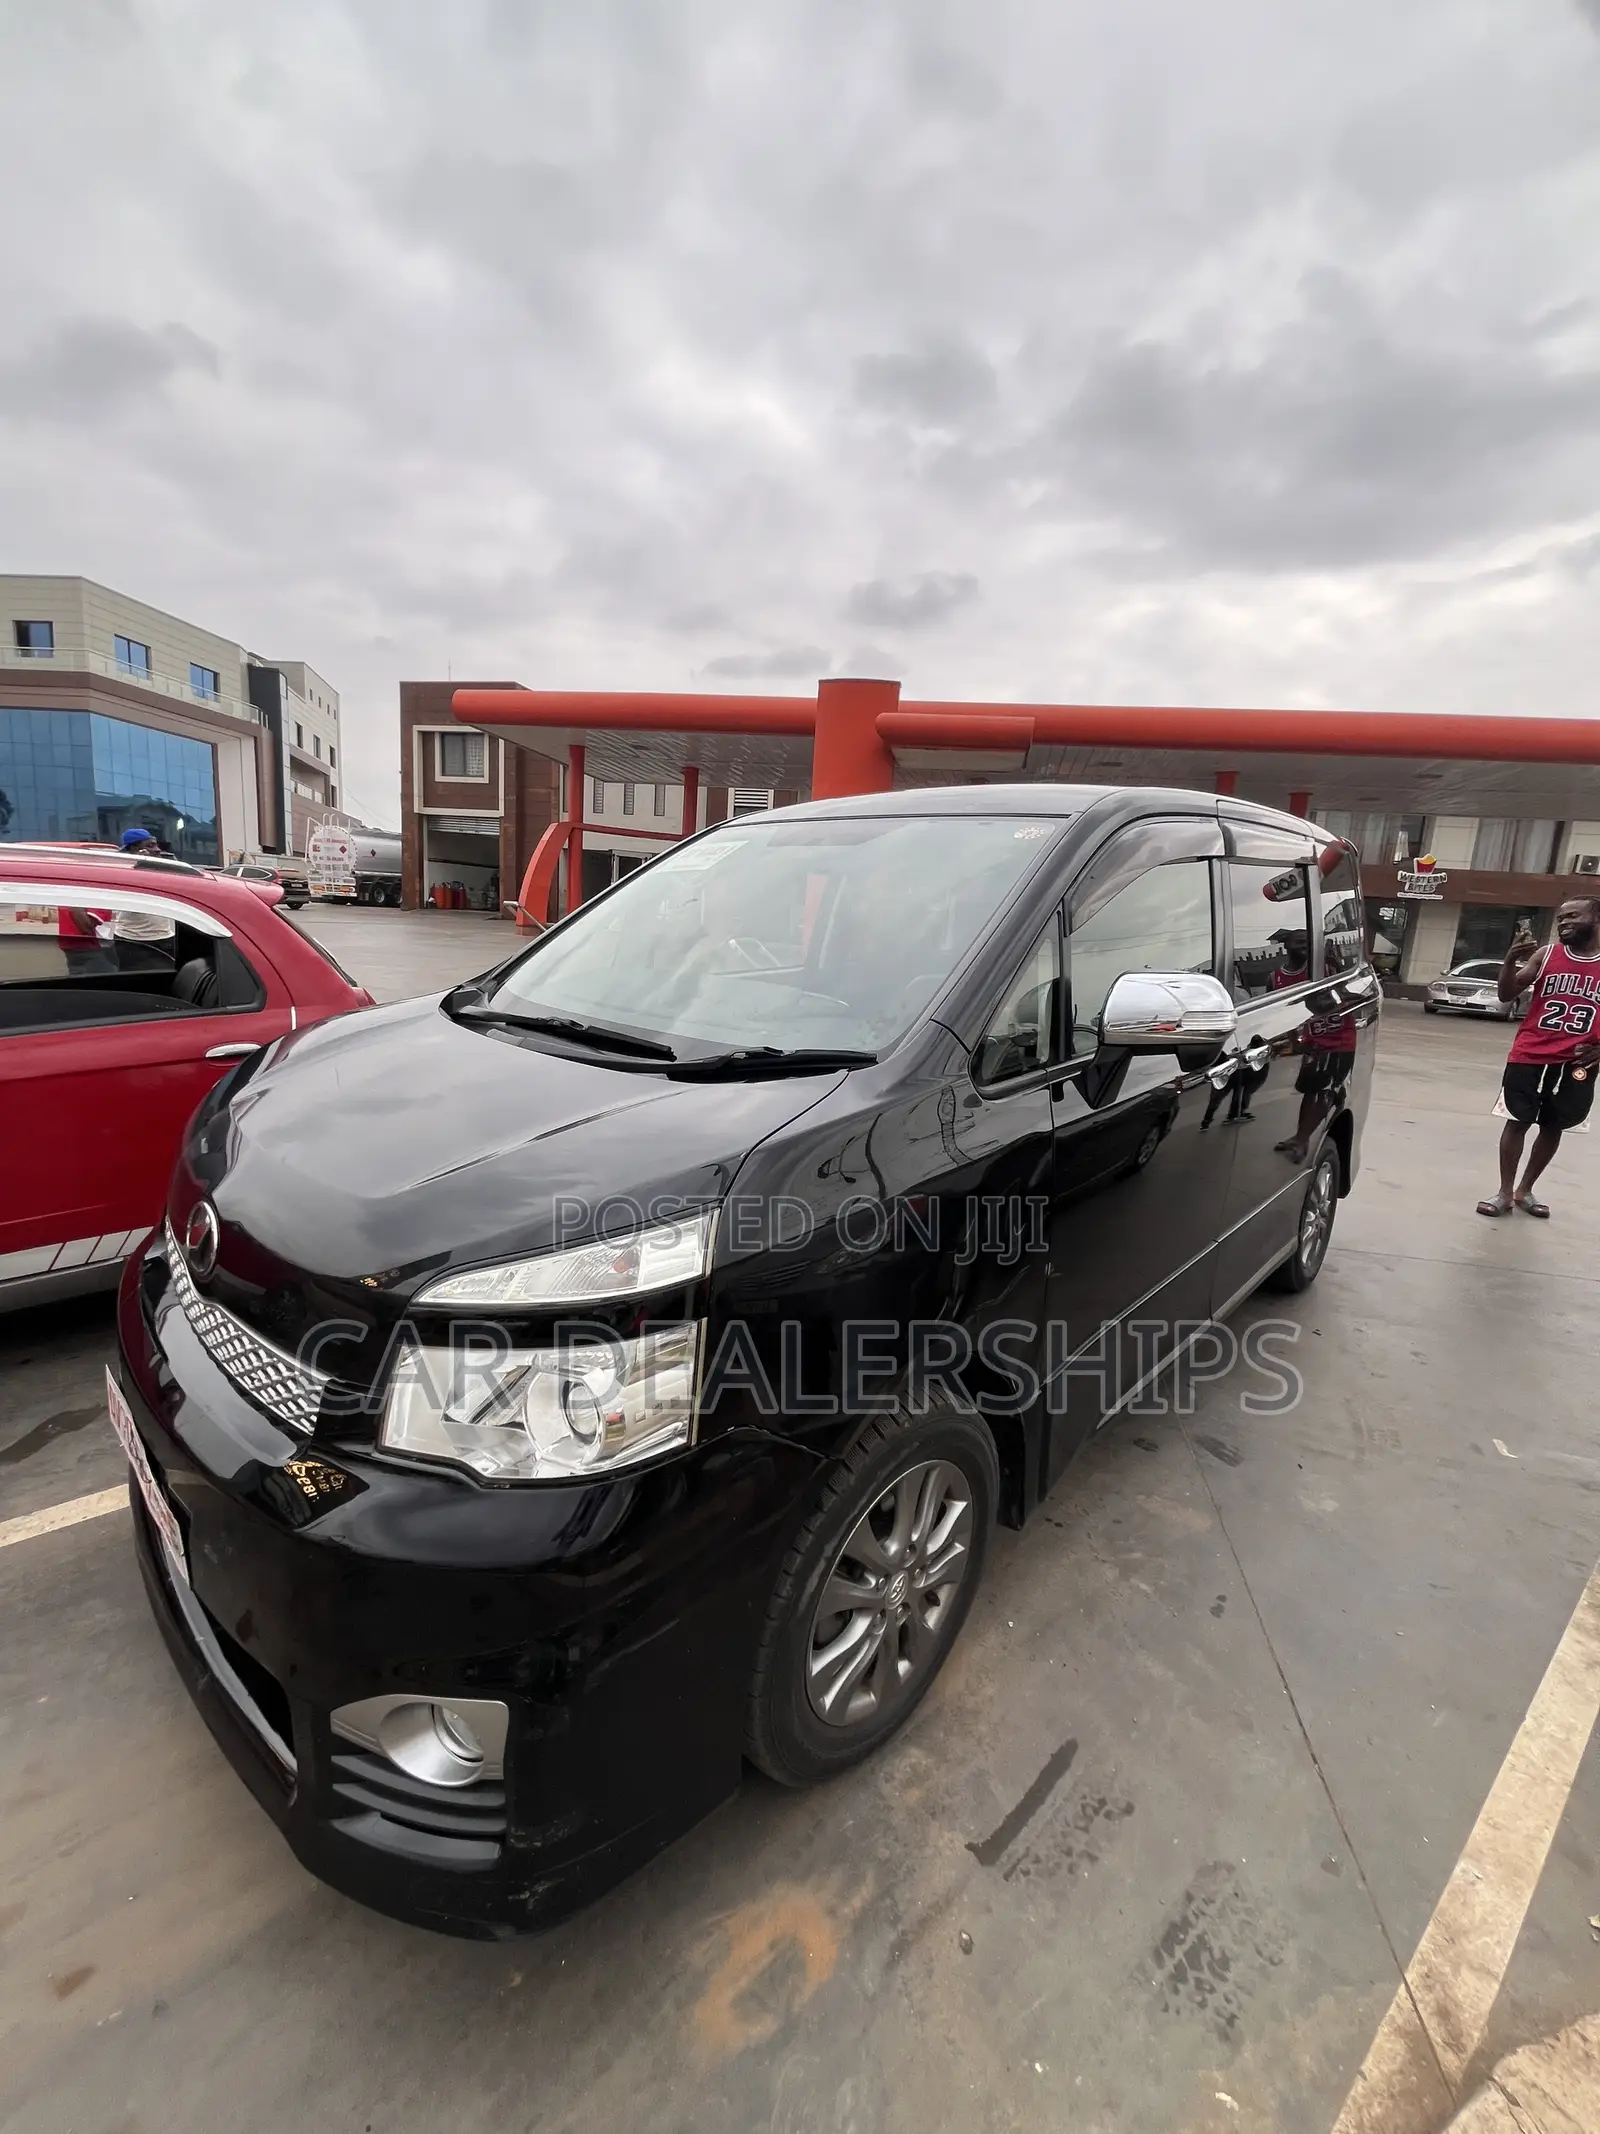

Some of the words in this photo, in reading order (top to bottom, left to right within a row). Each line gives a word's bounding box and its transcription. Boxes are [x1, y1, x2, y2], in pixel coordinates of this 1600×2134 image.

[1399, 871, 1447, 884] WESTERN
[1406, 882, 1436, 892] BITES
[1538, 1000, 1597, 1034] 23
